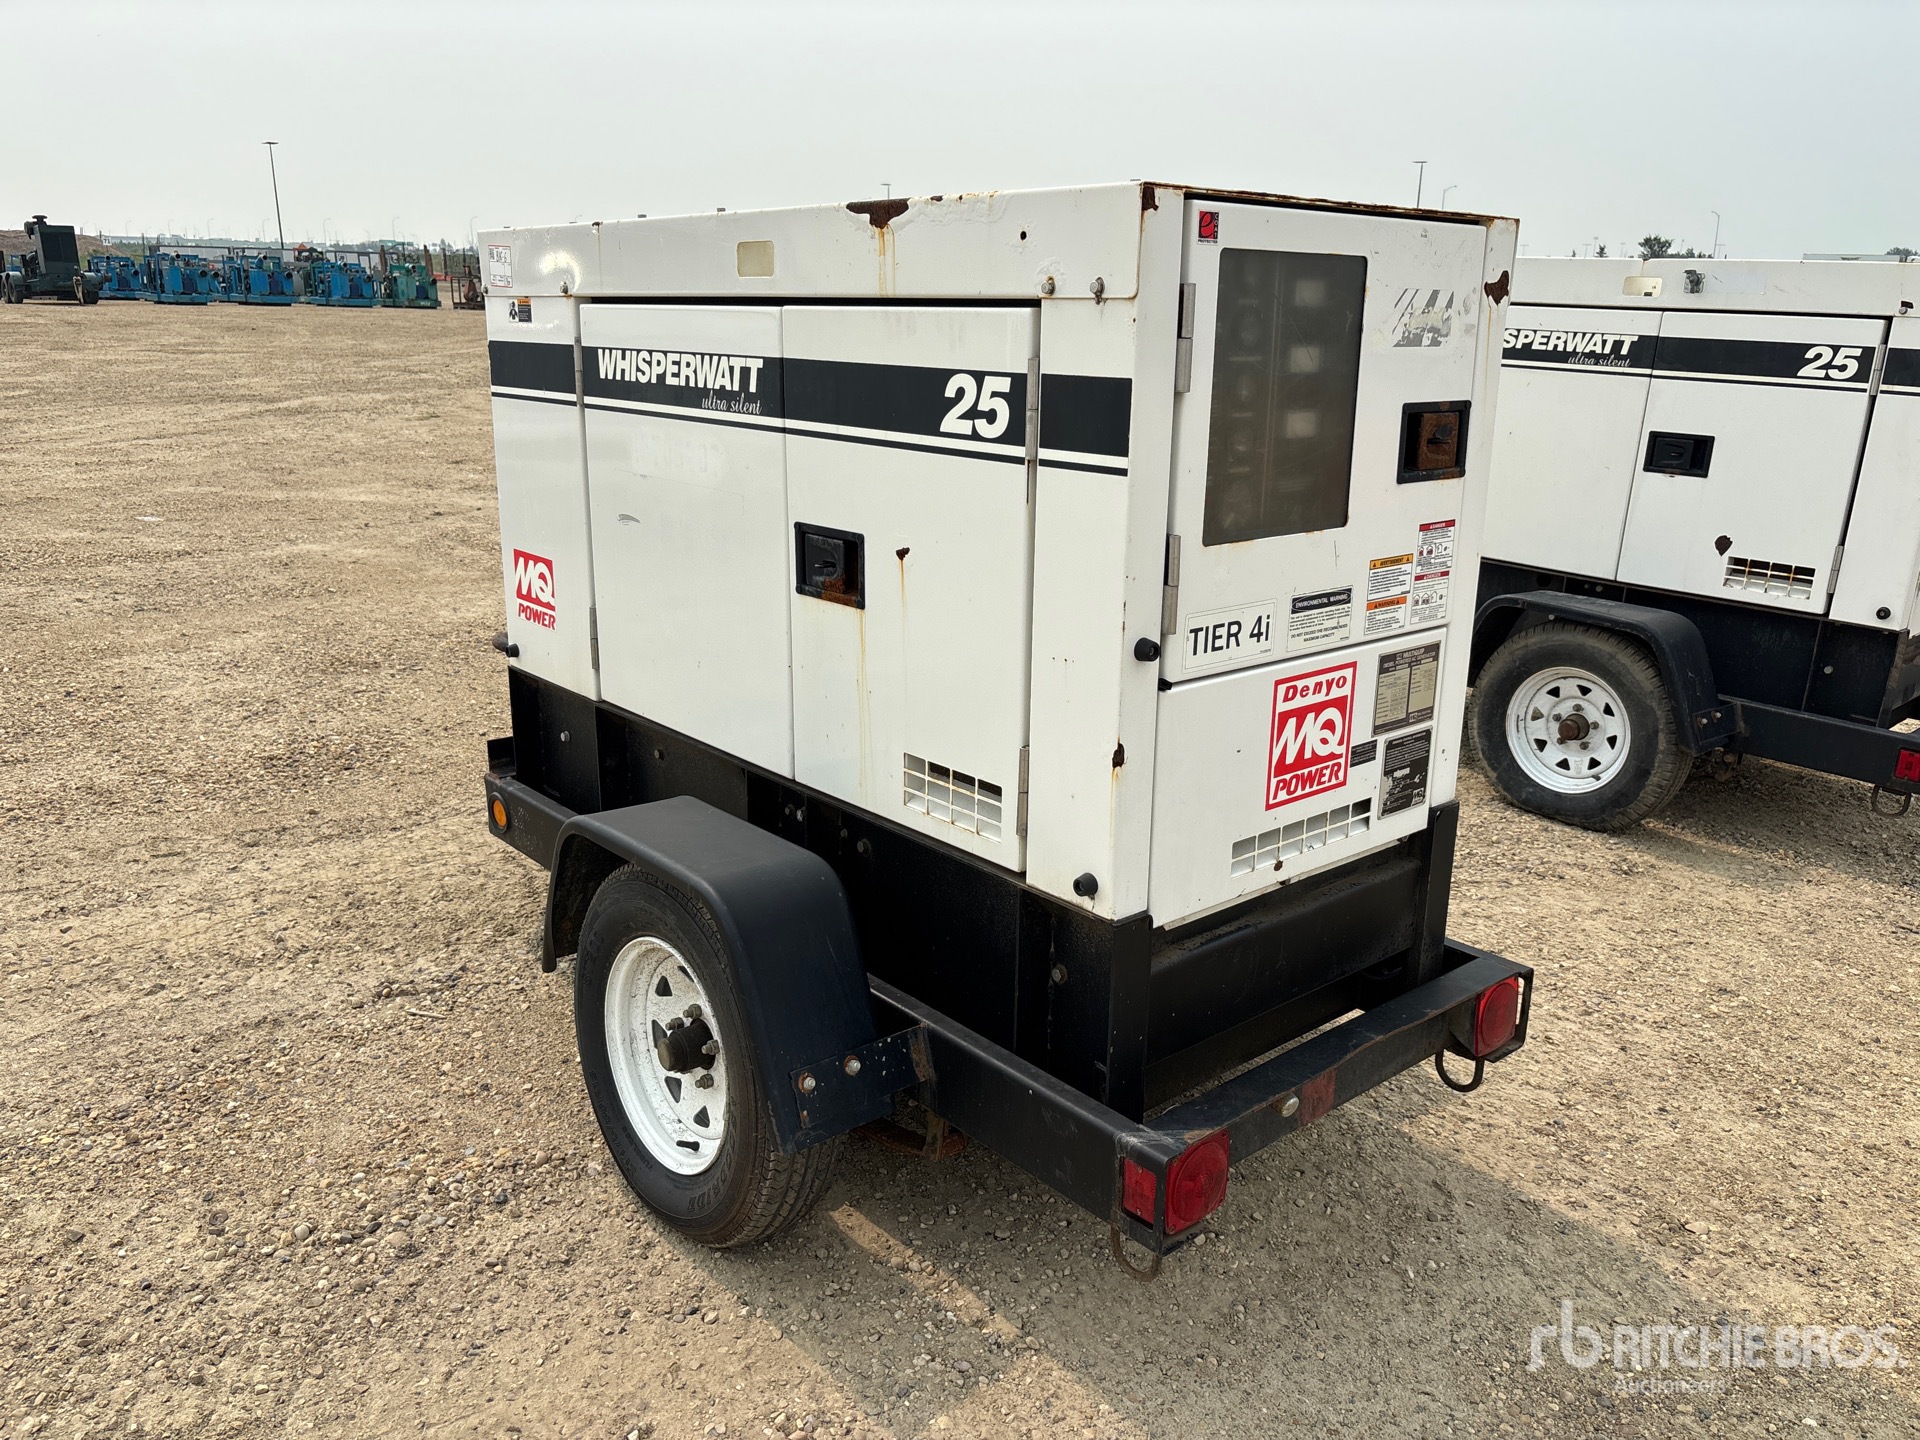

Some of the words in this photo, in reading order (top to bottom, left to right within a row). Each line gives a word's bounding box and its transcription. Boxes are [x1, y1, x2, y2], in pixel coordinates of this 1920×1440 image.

[597, 348, 764, 393] WHISPERWATT
[1567, 352, 1597, 365] ultra
[1597, 353, 1632, 367] silent
[1796, 345, 1863, 380] 25
[701, 389, 729, 412] ultra
[730, 392, 763, 415] silent
[939, 372, 1012, 439] 25
[515, 556, 555, 608] MQ
[518, 602, 556, 631] POWER
[1295, 597, 1329, 608] ENVIRONMENTAL
[1189, 620, 1243, 656] TIER
[1248, 614, 1271, 643] 4i
[1282, 675, 1347, 703] Denyo
[1274, 707, 1344, 766] MQ
[1272, 761, 1343, 801] POWER
